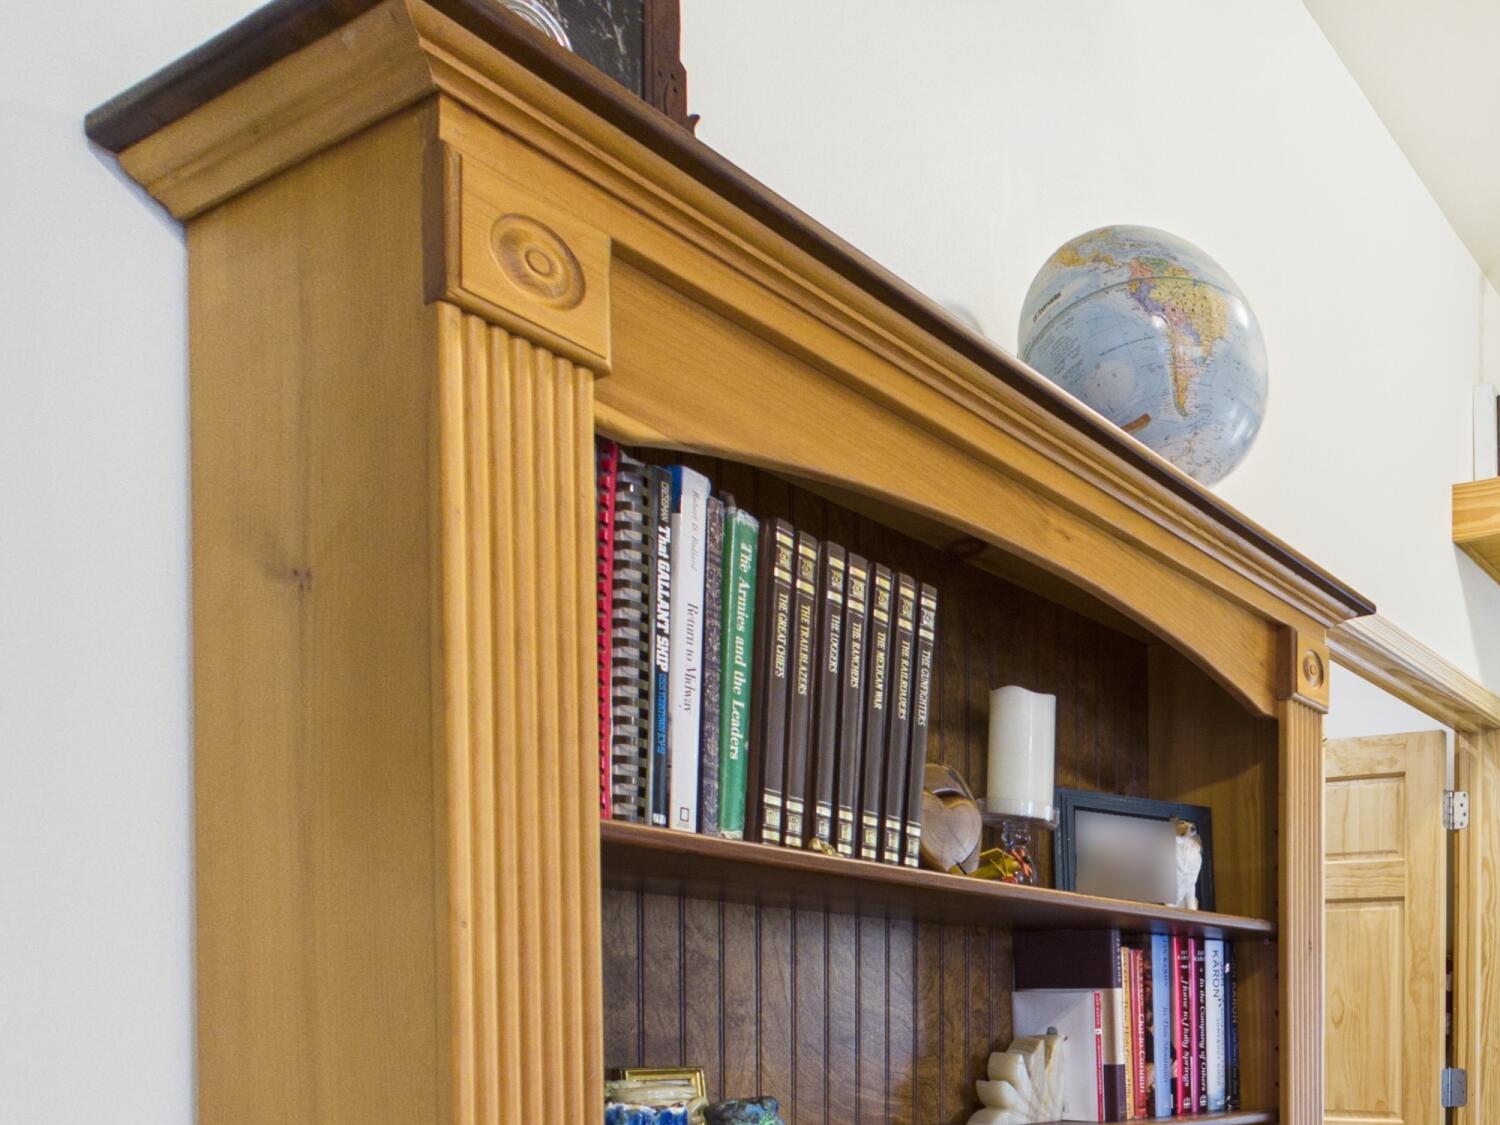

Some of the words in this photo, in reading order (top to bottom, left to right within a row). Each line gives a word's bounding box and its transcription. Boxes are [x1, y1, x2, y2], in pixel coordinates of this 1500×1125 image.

[657, 525, 671, 559] That
[740, 543, 753, 573] The
[656, 559, 670, 634] GALLANT
[736, 576, 751, 633] Armies
[778, 593, 789, 613] THE
[685, 603, 699, 646] Return
[777, 612, 787, 646] GREAT
[801, 604, 811, 625] THE
[831, 614, 841, 633] THE
[852, 622, 862, 641] THE
[656, 634, 669, 673] SHIP
[686, 649, 694, 662] to
[735, 636, 747, 668] and
[829, 632, 840, 674] LOGGERS
[876, 631, 887, 651] THE
[901, 640, 911, 660] THE
[775, 645, 786, 679] CHIEFS
[798, 625, 810, 697] TRAILBLAZERS
[850, 641, 861, 689] RANCHERS
[874, 650, 886, 691] MEXICAN
[921, 650, 931, 668] THE
[679, 667, 697, 711] Midway
[733, 669, 747, 696] the
[898, 659, 910, 721] RAILROADERS
[917, 667, 930, 728] GUNFIGHTERS
[873, 690, 883, 711] WAR
[729, 699, 745, 761] Leaders
[1212, 950, 1221, 999] KARON
